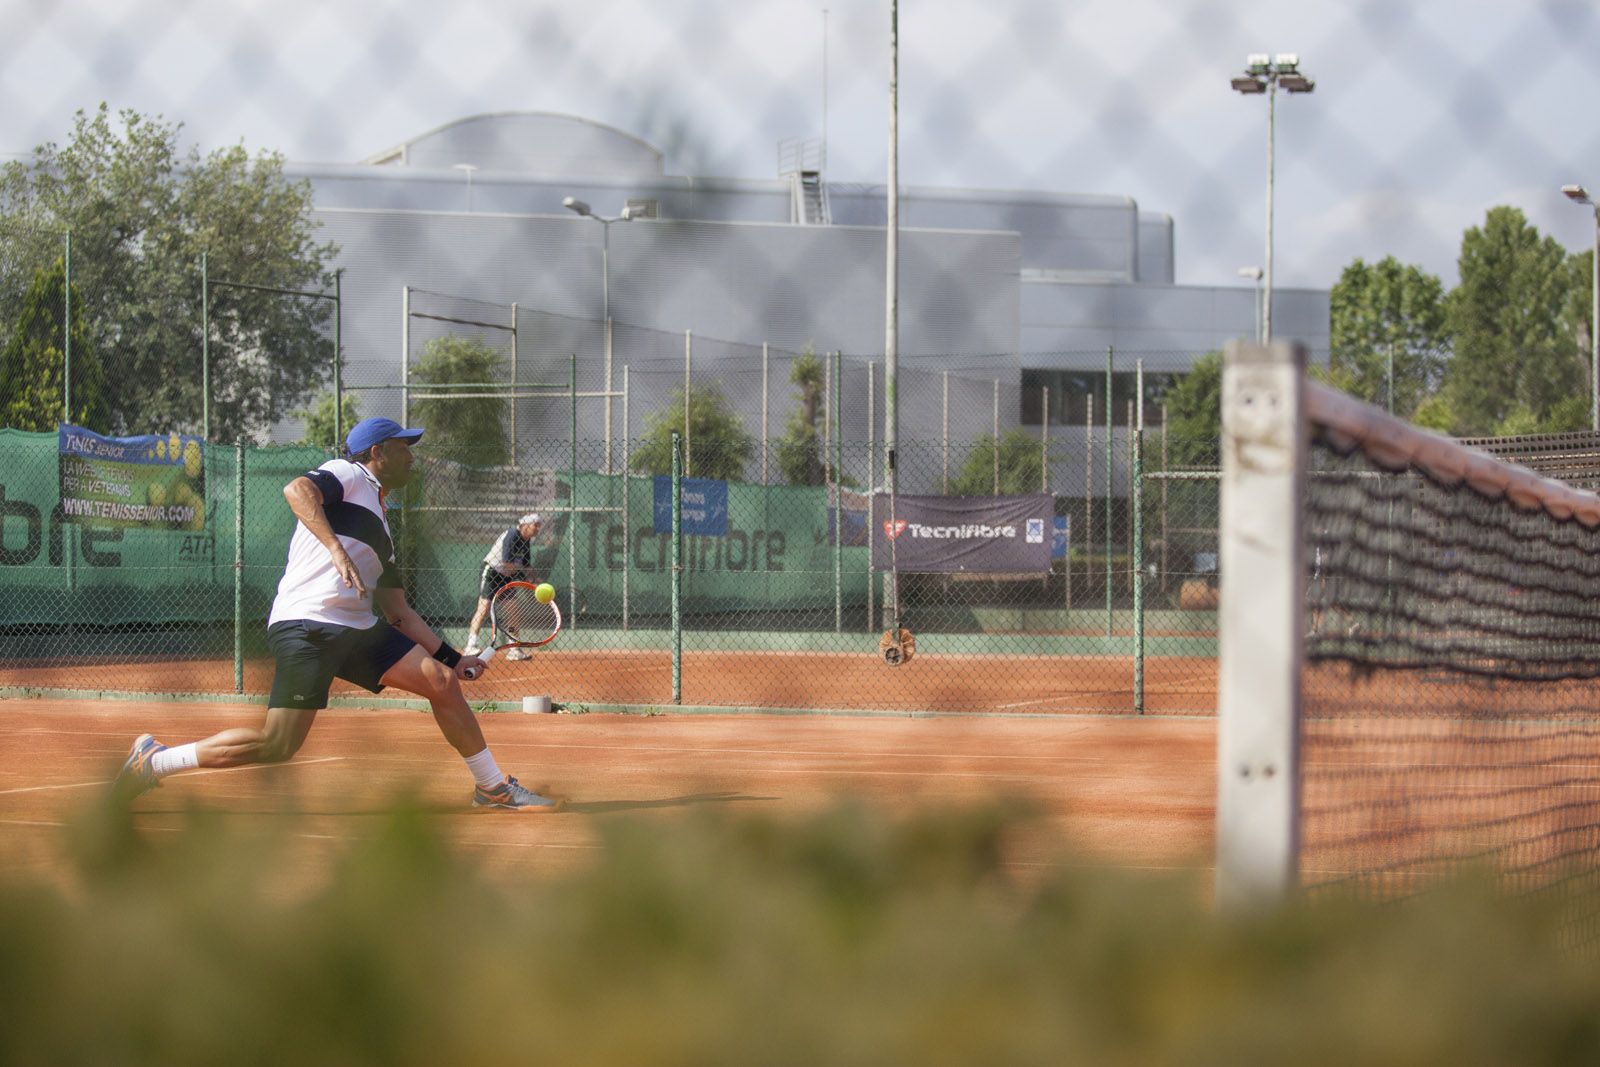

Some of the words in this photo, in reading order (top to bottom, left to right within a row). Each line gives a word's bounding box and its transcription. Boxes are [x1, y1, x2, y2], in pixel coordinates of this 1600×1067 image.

[95, 444, 125, 458] SENIOR
[64, 498, 194, 521] WWW.TENISSENIOR.COM
[908, 523, 1016, 539] Tecnifibre
